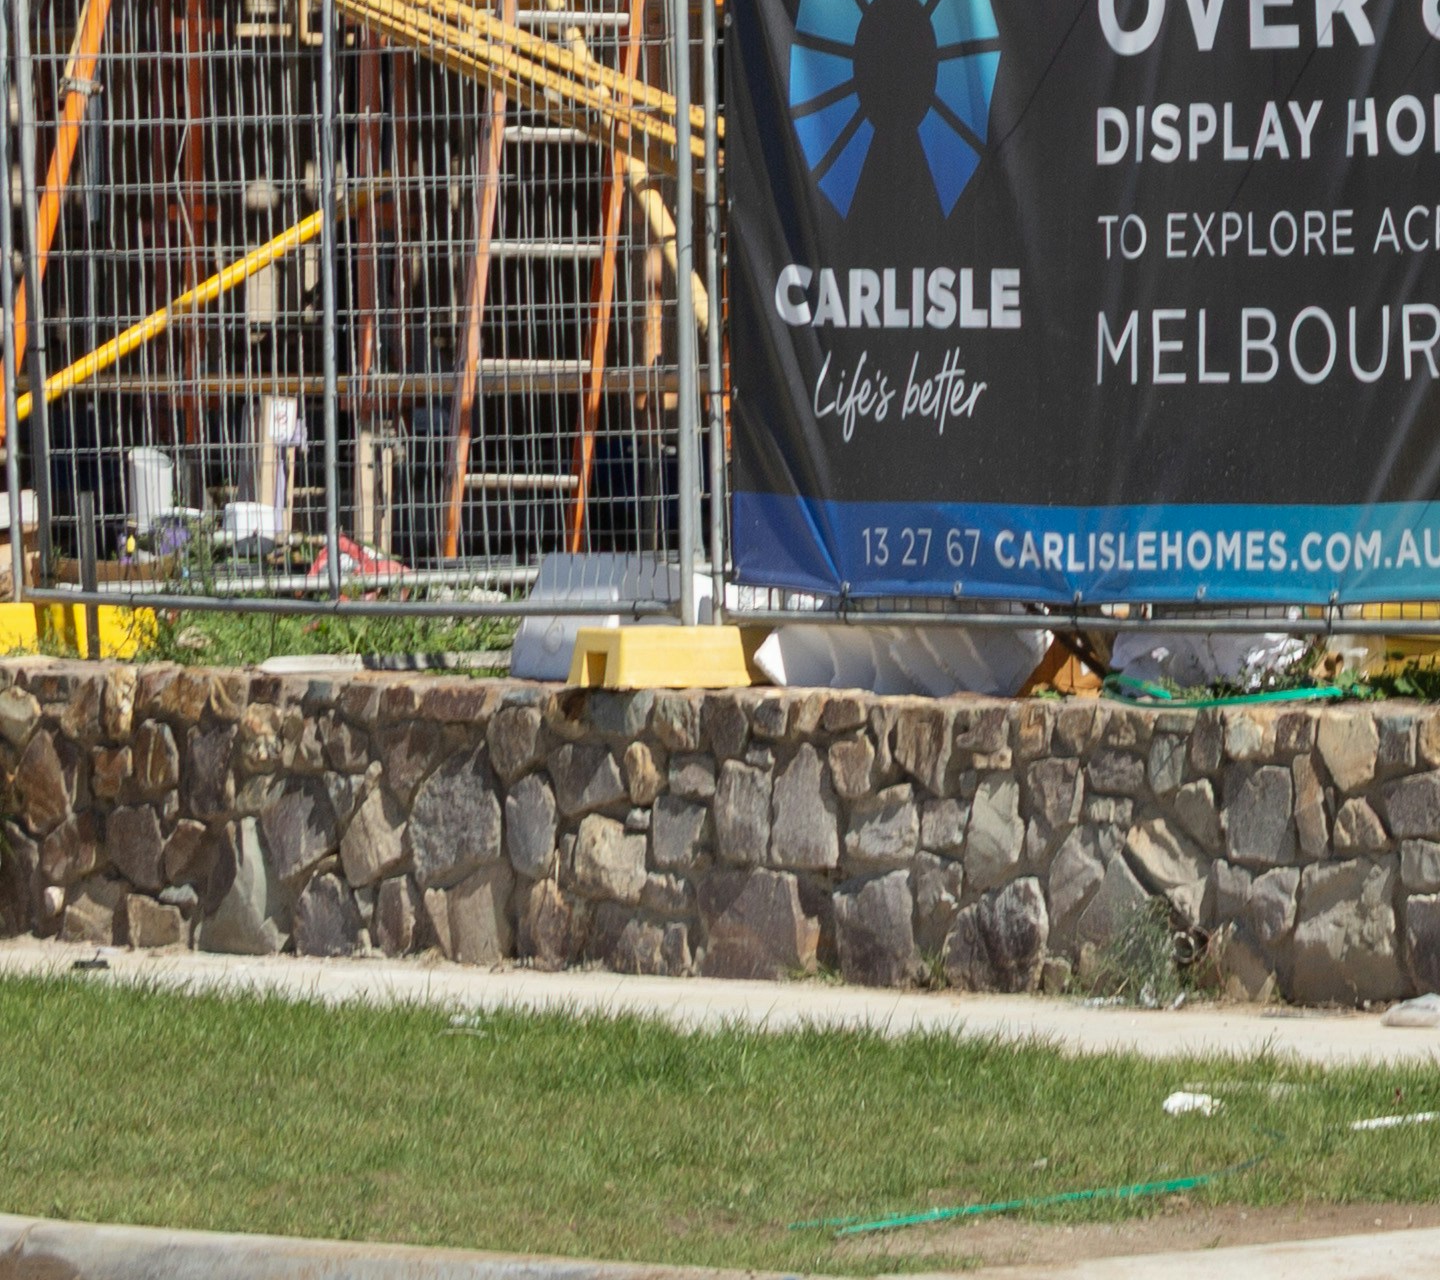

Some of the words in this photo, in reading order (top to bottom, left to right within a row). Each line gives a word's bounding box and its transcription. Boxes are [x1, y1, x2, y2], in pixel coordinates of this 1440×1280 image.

[1096, 97, 1324, 166] DISPLAY
[1098, 213, 1146, 261] TO
[1166, 207, 1354, 259] EXPLORE
[774, 264, 1022, 330] CARLISLE
[814, 346, 894, 442] Life's
[902, 350, 987, 435] better
[862, 528, 890, 567] 13
[900, 528, 931, 567] 27
[946, 527, 981, 566] 67
